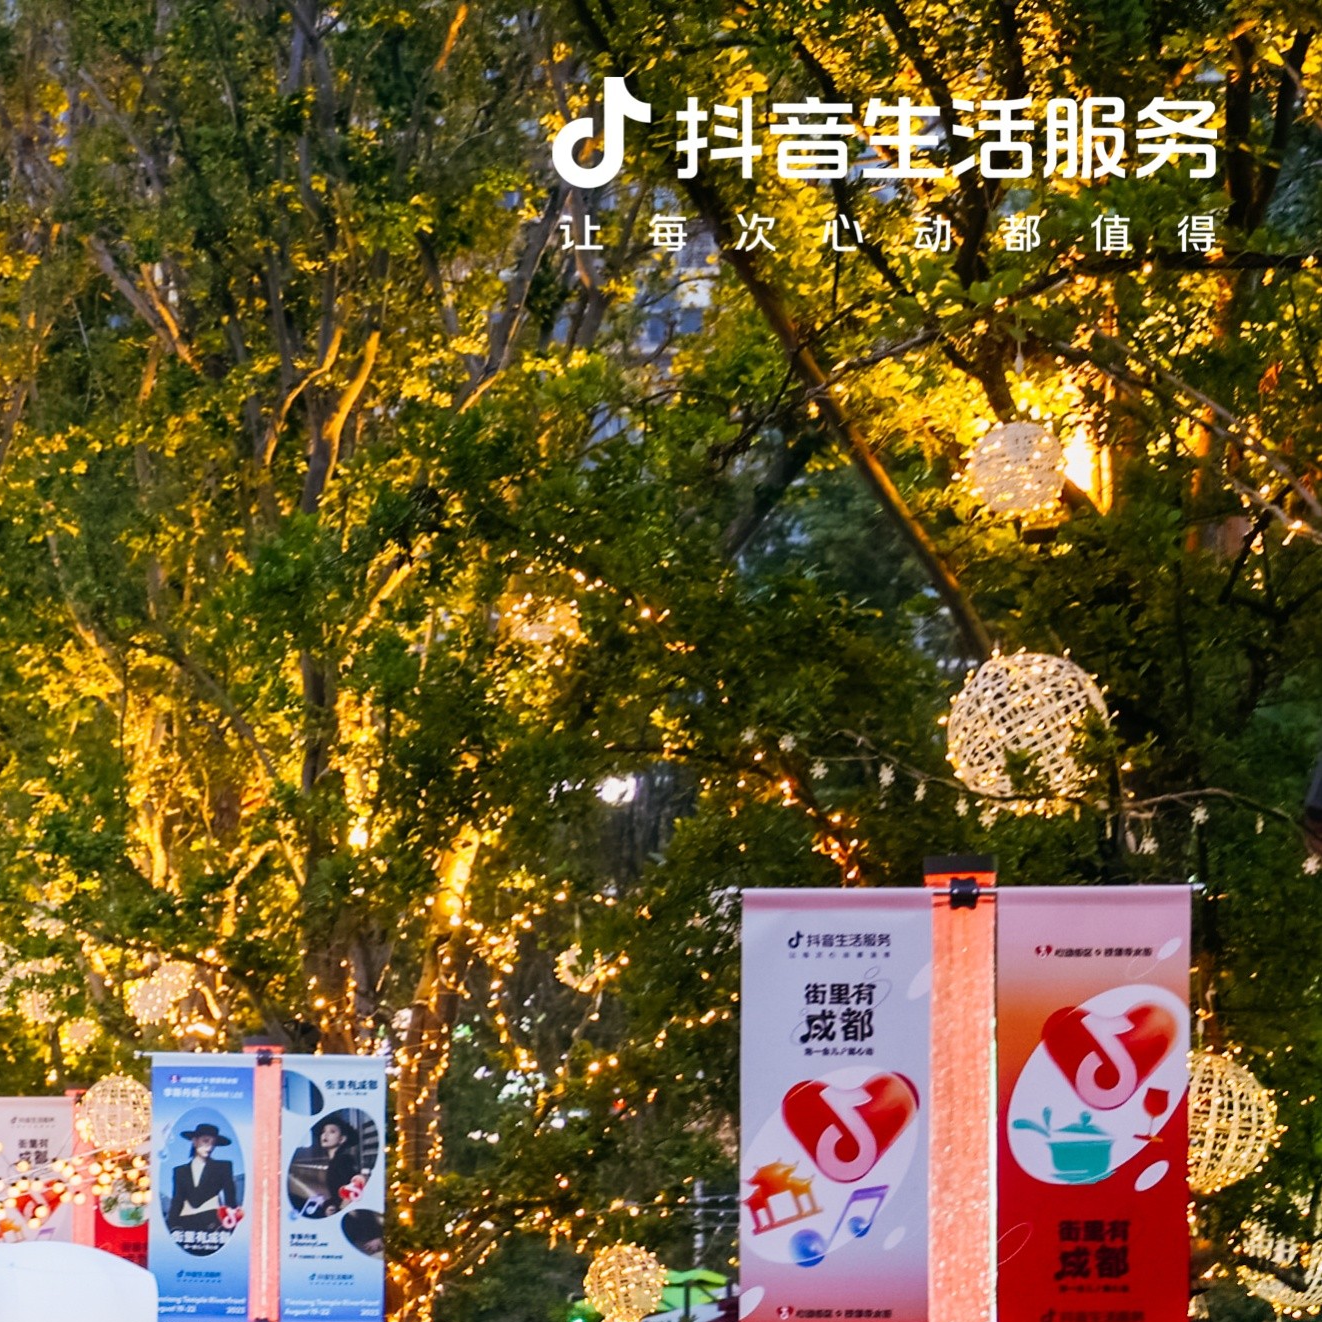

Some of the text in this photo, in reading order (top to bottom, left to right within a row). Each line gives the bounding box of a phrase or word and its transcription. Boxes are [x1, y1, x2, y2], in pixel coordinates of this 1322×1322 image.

[804, 982, 877, 1005] 街里有
[799, 1008, 874, 1043] 成都
